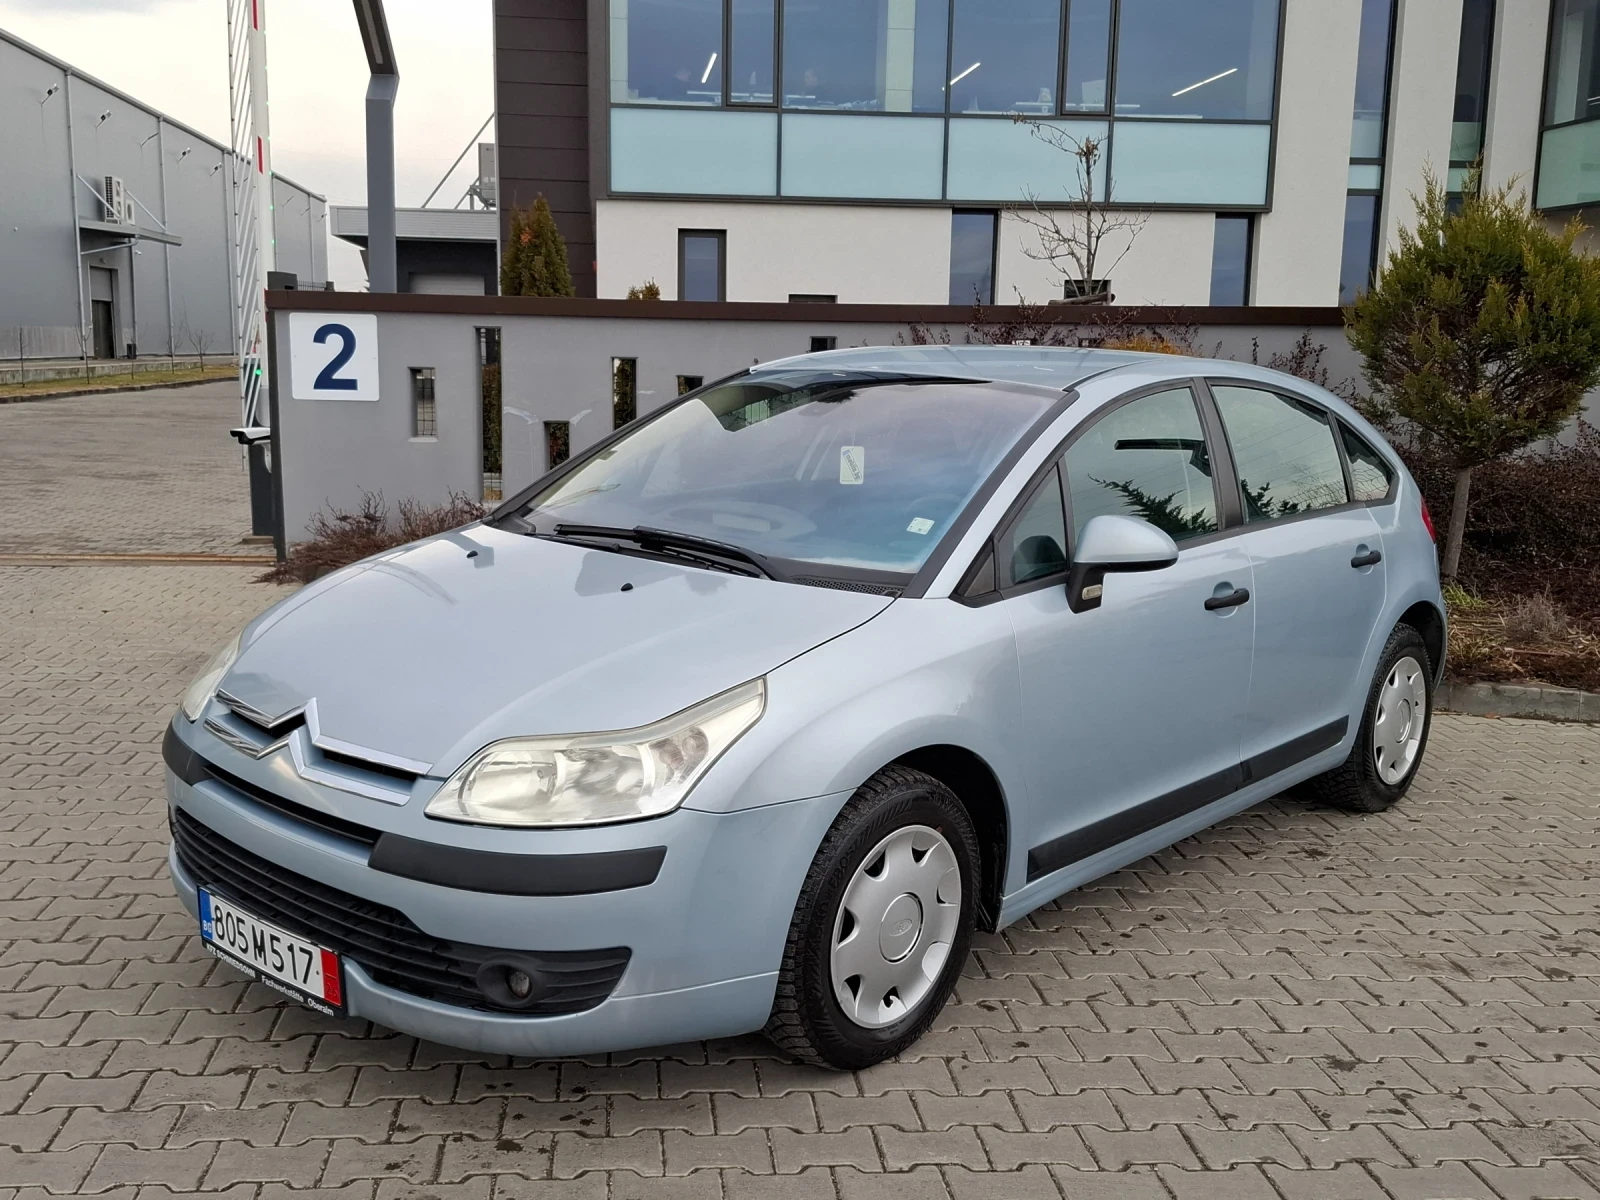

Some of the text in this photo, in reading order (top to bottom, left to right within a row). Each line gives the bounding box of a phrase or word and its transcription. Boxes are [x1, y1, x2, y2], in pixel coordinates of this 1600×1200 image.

[313, 323, 358, 391] 2
[203, 920, 212, 934] BG
[214, 904, 313, 985] 805M517
[307, 997, 334, 1017] Oberalm
